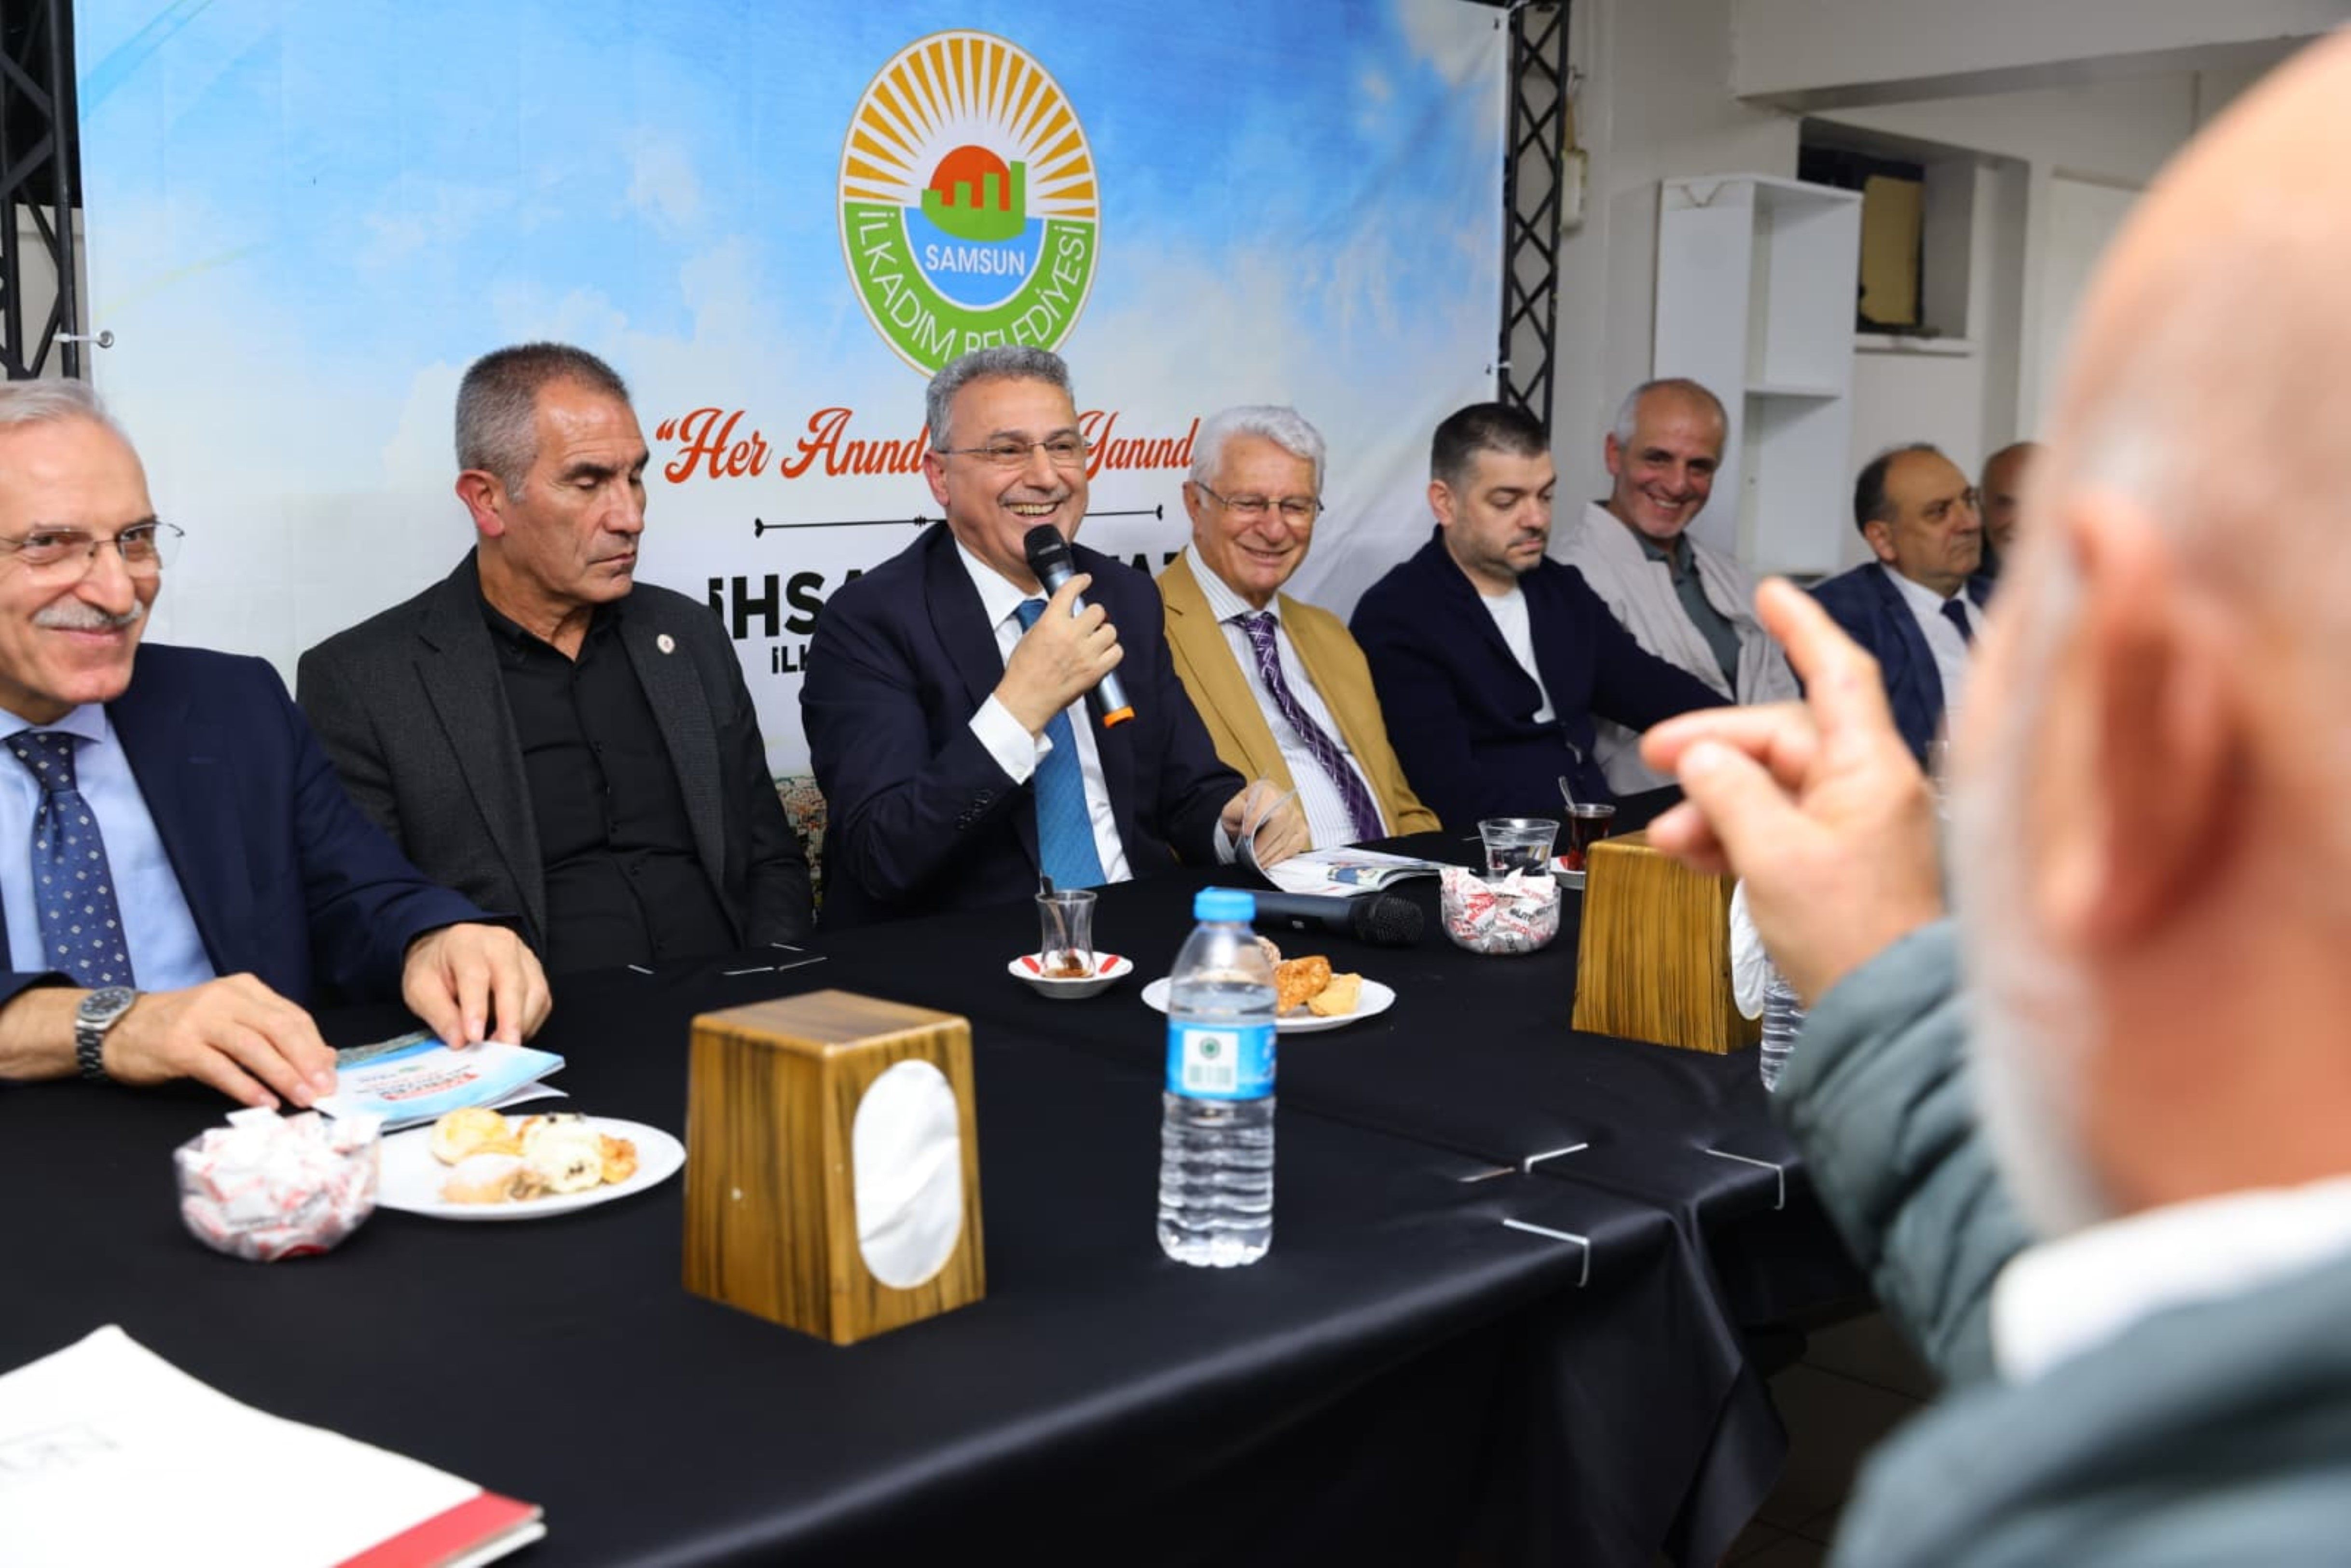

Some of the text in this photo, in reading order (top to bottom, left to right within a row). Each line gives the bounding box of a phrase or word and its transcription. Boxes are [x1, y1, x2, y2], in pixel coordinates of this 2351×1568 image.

[858, 210, 956, 362] İLKADIM
[925, 244, 1025, 276] SAMSUN
[781, 407, 930, 478] Anınd
[1078, 410, 1200, 481] Yanınd
